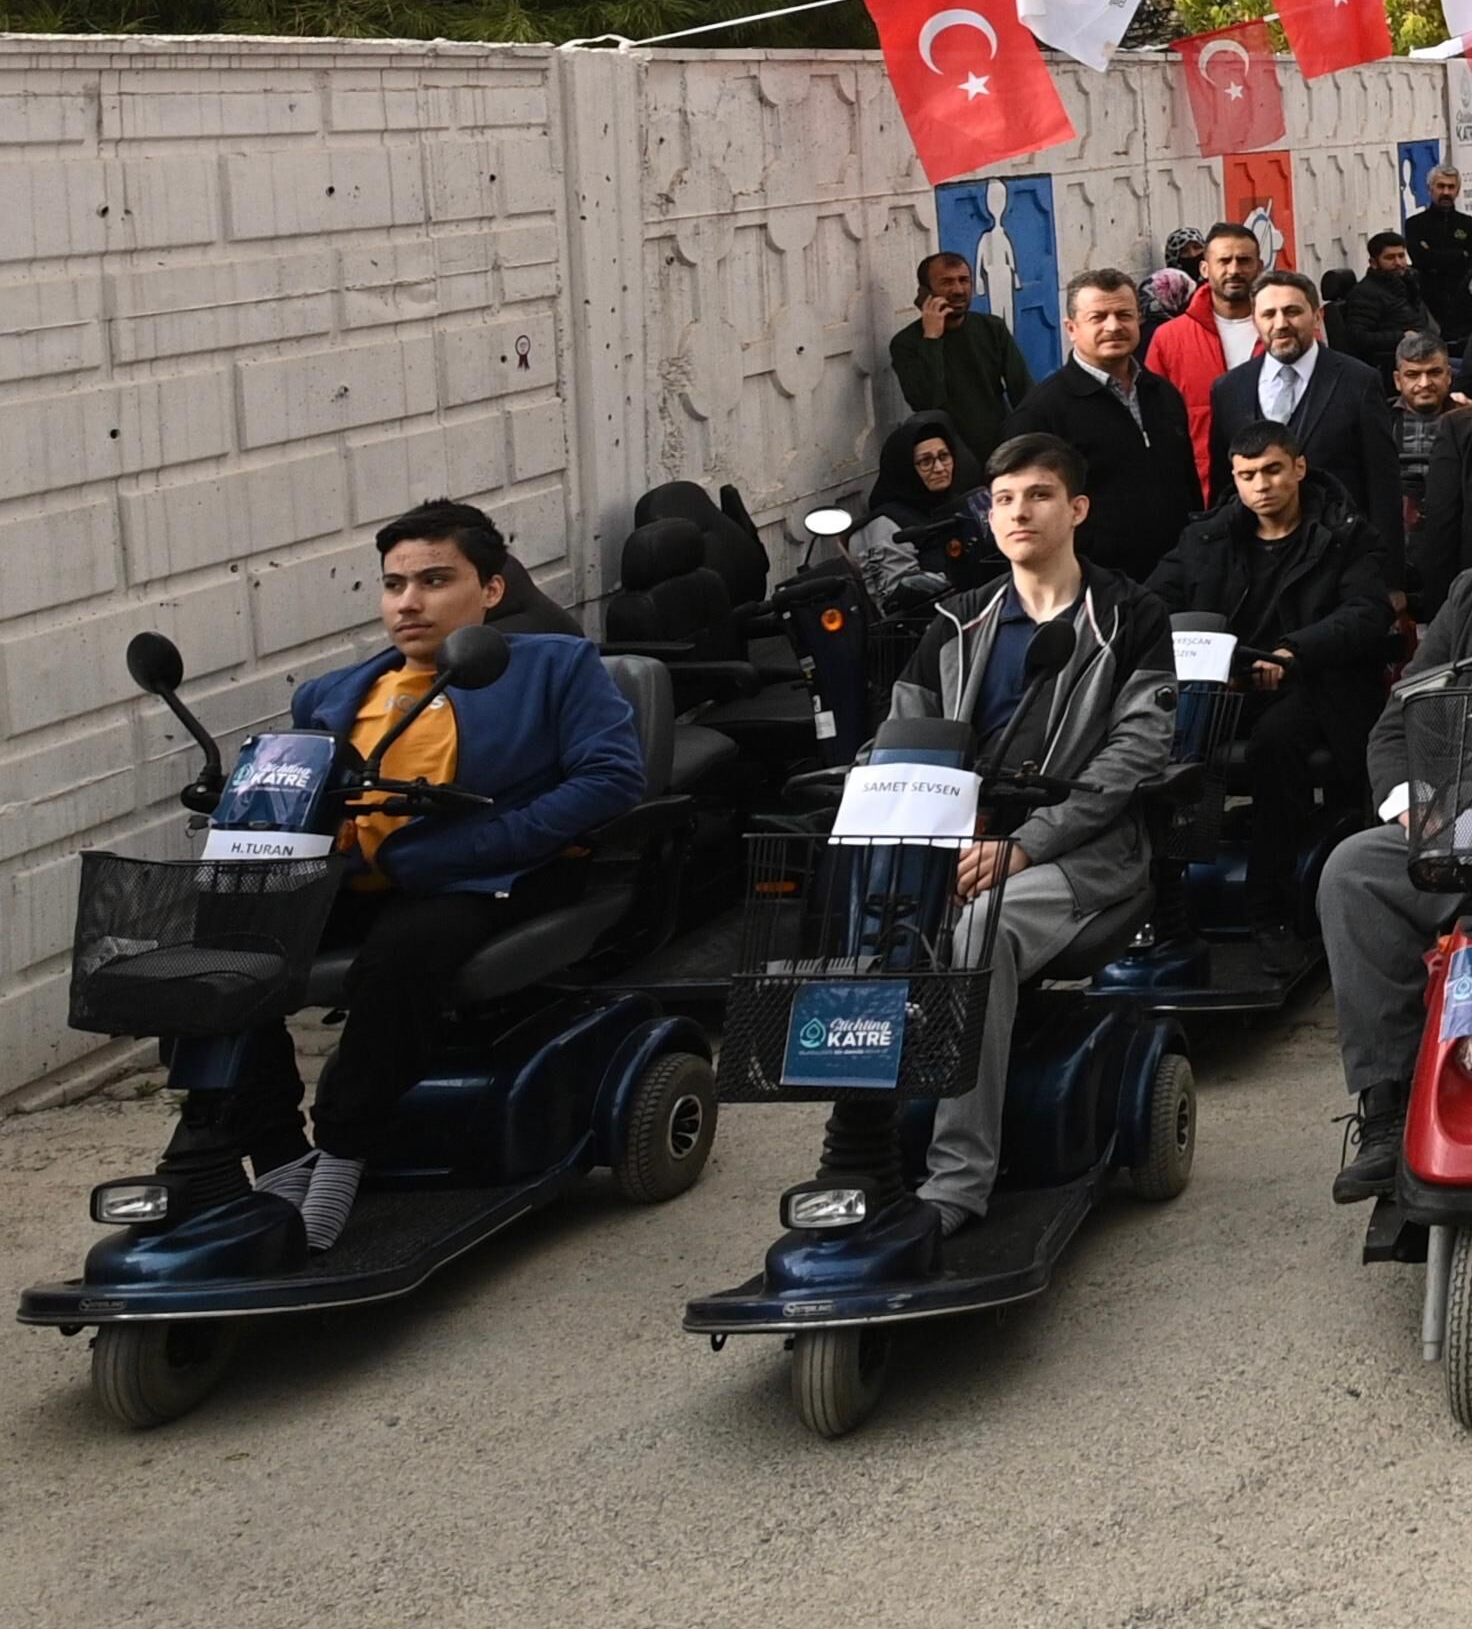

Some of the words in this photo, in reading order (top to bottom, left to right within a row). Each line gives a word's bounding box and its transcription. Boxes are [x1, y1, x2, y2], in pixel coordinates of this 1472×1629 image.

[252, 772, 311, 788] KATRE
[863, 781, 907, 793] SAMET
[910, 781, 961, 797] SEVSEN
[231, 842, 294, 856] H.TURAN
[829, 1017, 891, 1034] Stichting
[827, 1031, 892, 1047] KATRE
